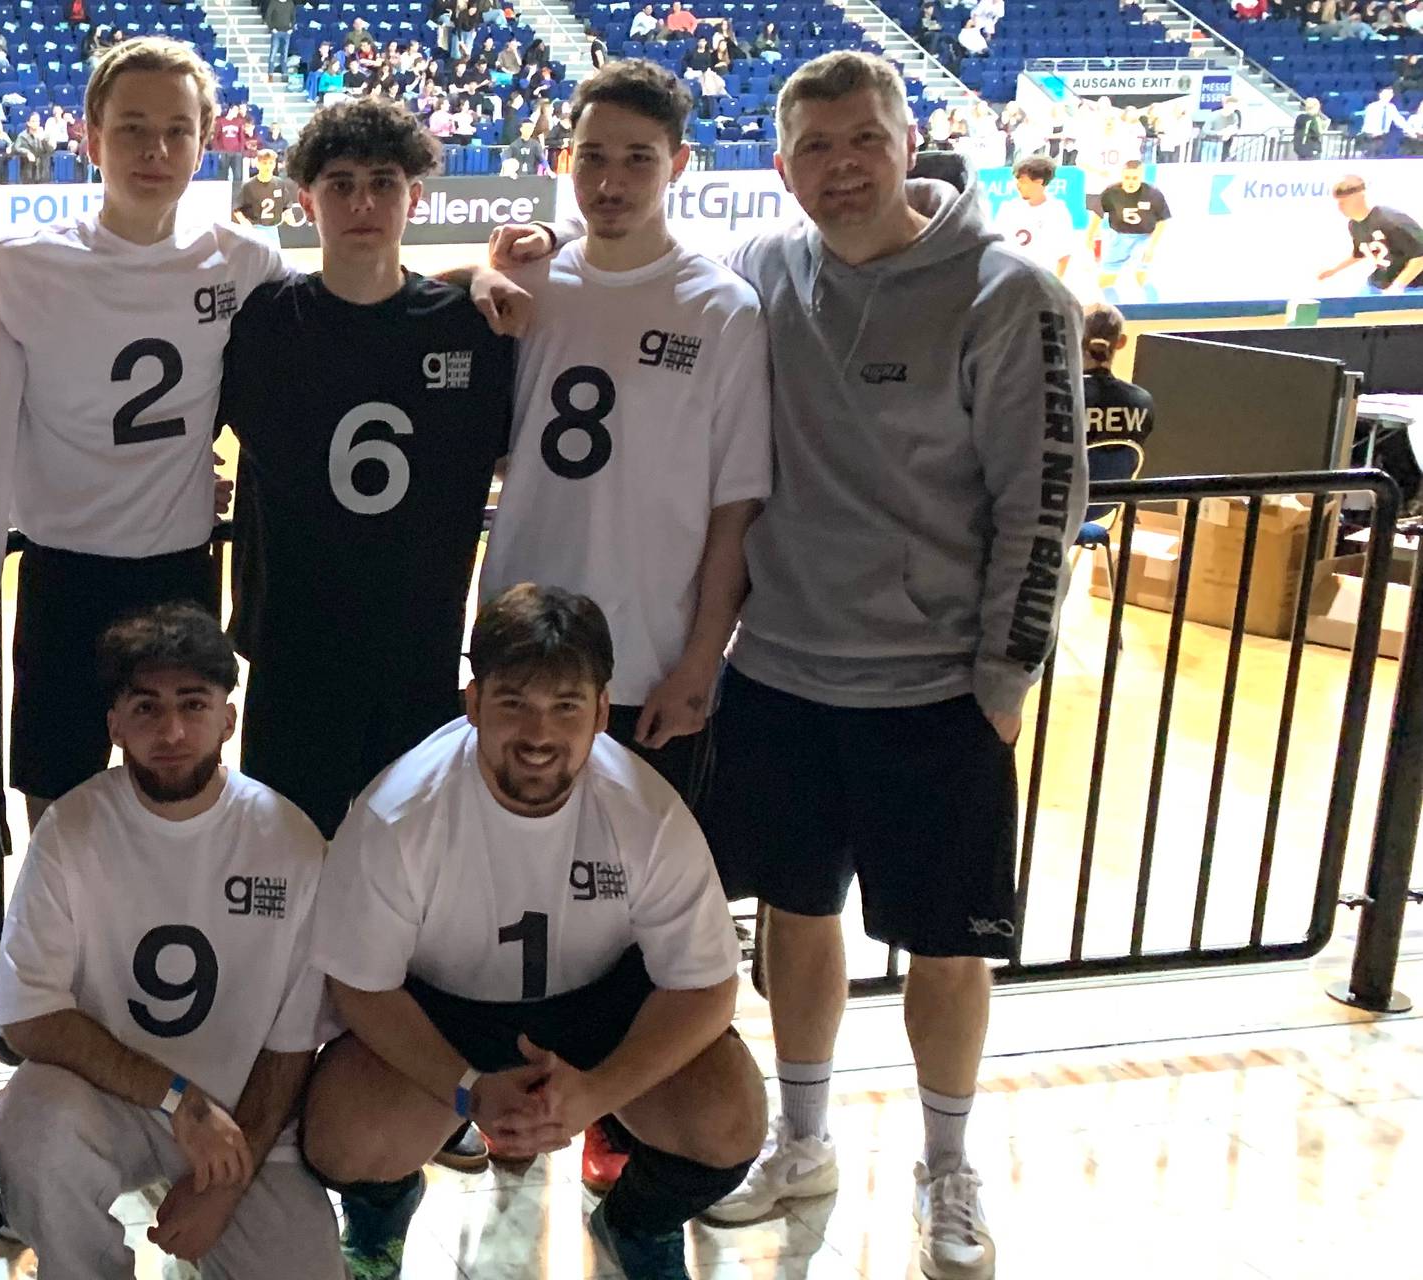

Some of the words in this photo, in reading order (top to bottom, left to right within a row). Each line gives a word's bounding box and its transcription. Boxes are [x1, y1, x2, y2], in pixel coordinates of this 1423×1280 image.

[1073, 77, 1136, 89] AUSGANG
[1201, 82, 1231, 92] MESSE
[260, 198, 275, 219] 2
[1122, 207, 1142, 225] 5
[110, 338, 187, 446] 2
[1038, 311, 1074, 443] NEVER
[328, 402, 414, 515] 6
[540, 365, 616, 480] 8
[1038, 451, 1074, 532] NOT
[127, 924, 219, 1038] 9
[498, 910, 549, 999] 1
